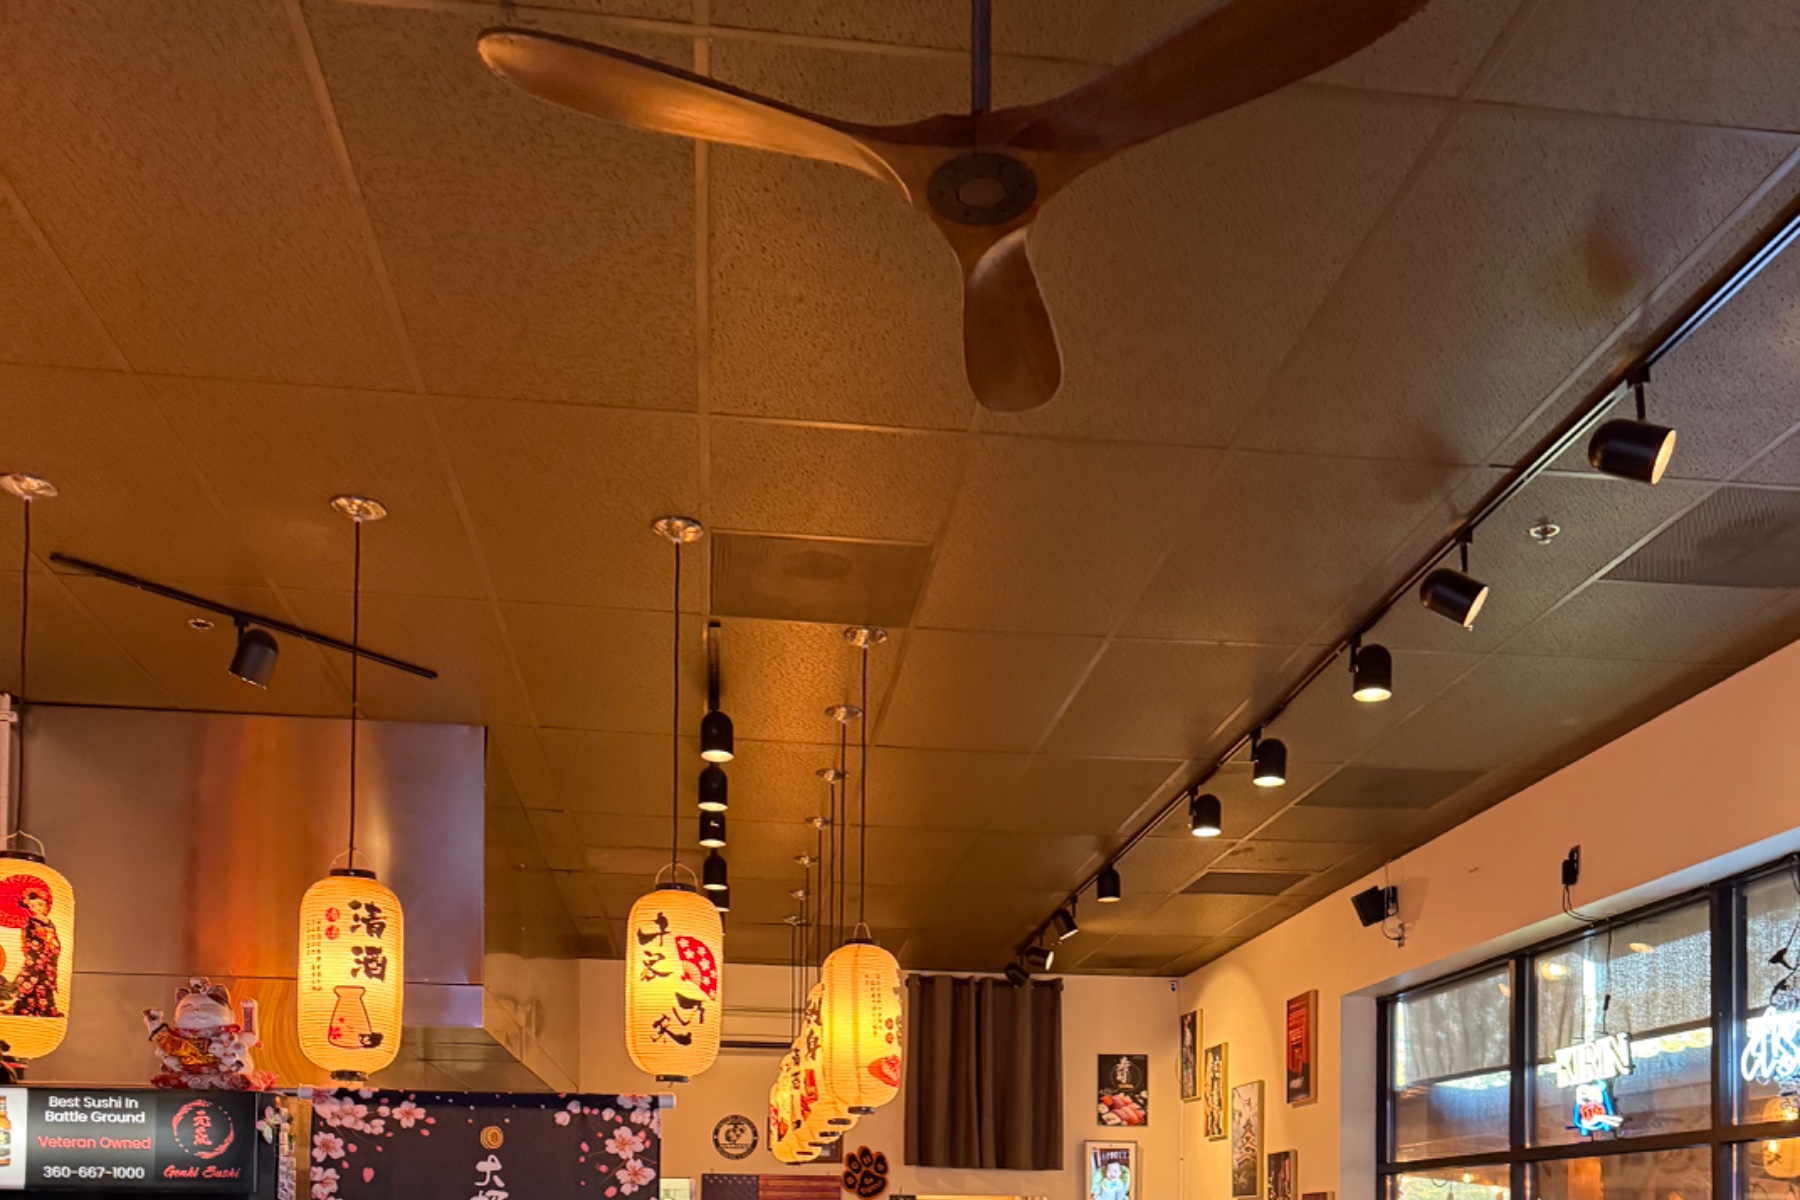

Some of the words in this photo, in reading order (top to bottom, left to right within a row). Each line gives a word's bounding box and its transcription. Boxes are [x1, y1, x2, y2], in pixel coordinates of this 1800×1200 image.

[348, 900, 388, 982] 清酒
[48, 1096, 81, 1108] Best
[83, 1096, 121, 1109] Sushi
[125, 1097, 139, 1109] In
[45, 1110, 88, 1122] Battle
[90, 1111, 145, 1123] Ground
[37, 1136, 96, 1149] Veteran
[99, 1136, 152, 1150] Owned
[43, 1165, 145, 1179] 360-667-1000
